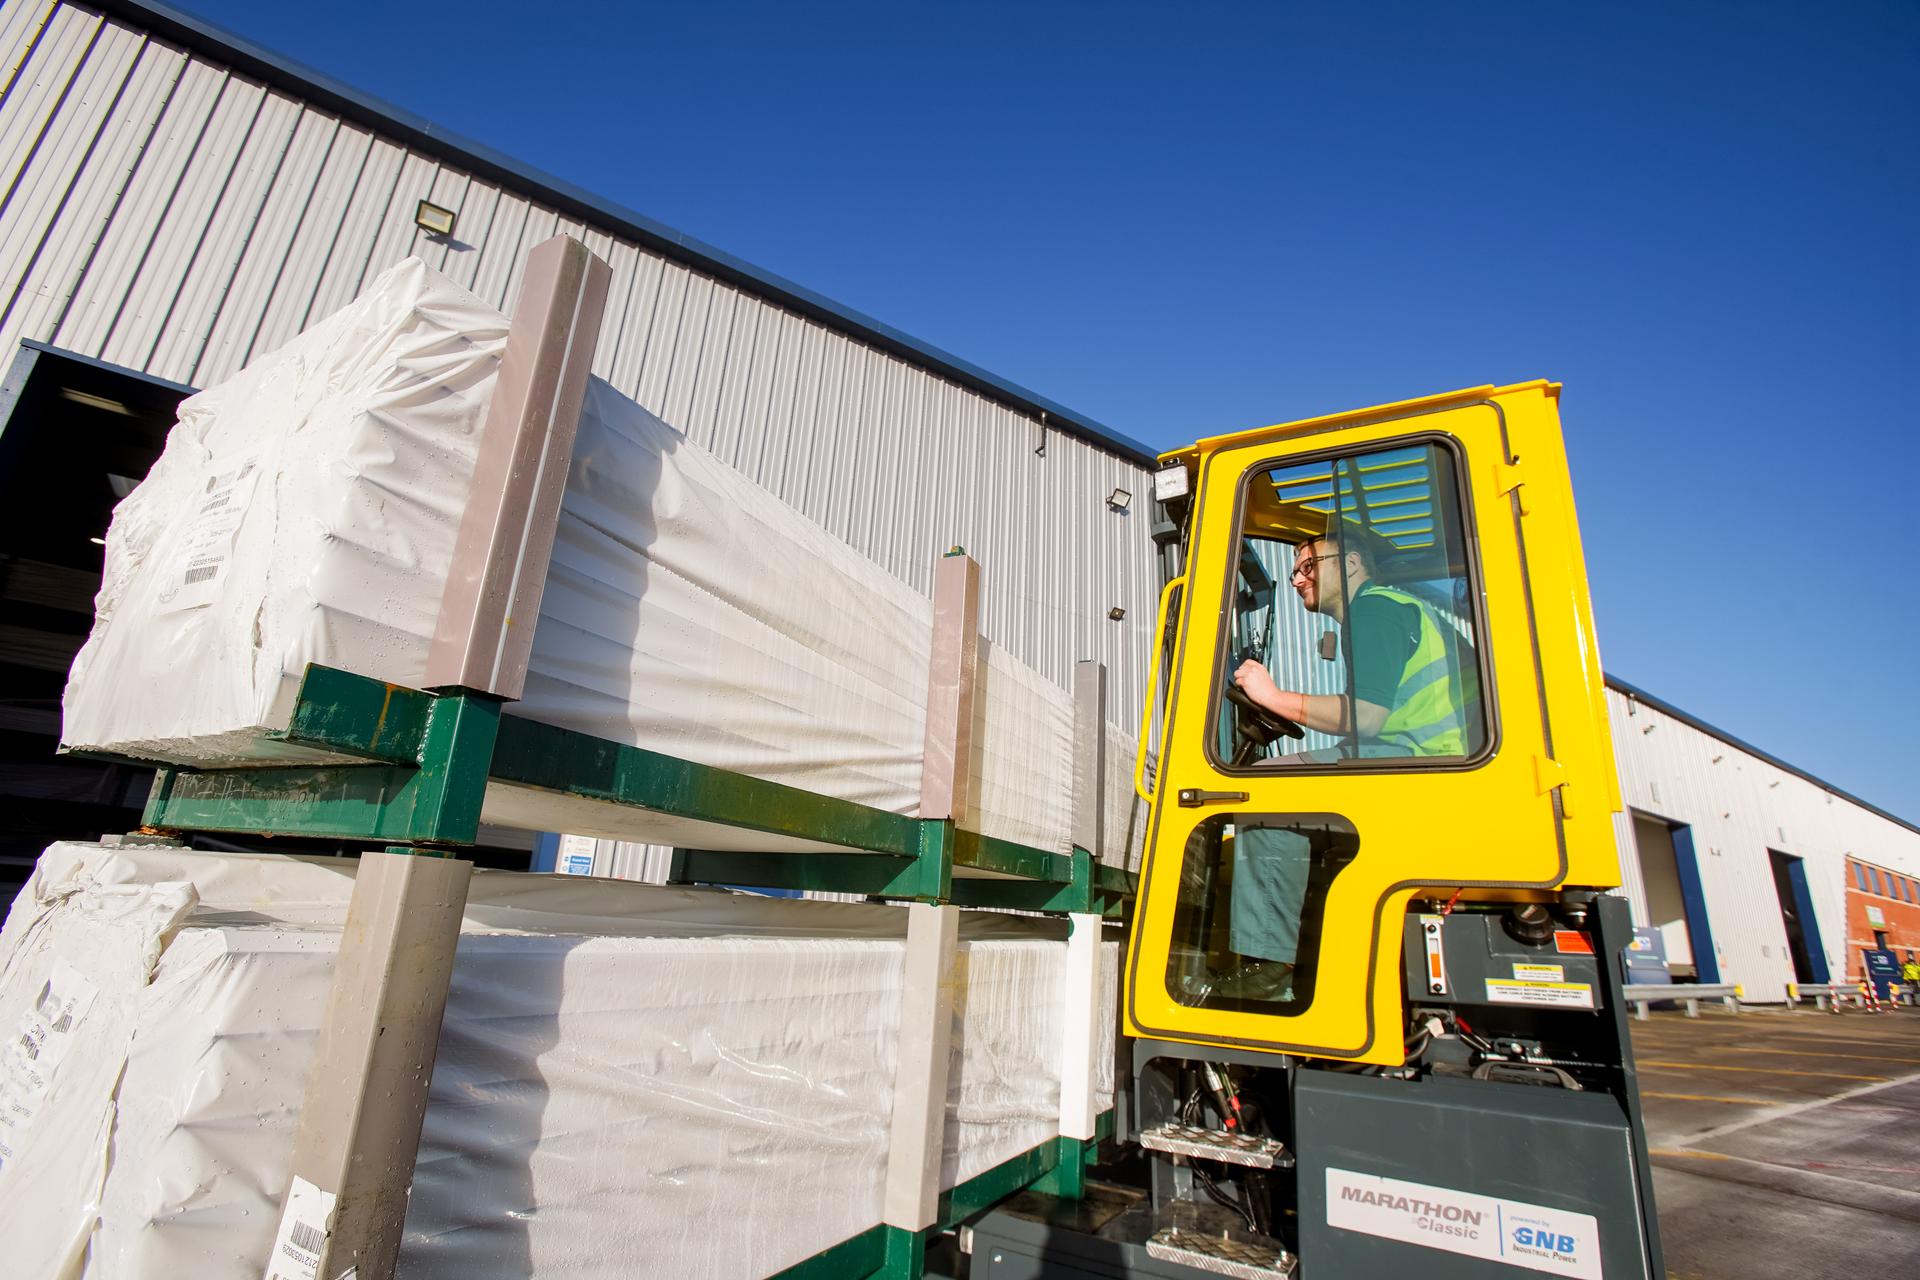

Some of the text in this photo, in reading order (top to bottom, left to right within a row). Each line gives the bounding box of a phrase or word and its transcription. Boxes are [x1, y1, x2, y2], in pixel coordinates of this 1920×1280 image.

[1341, 1186, 1482, 1226] MARATHON
[1416, 1216, 1479, 1240] Classic
[1510, 1215, 1550, 1228] powered by
[1512, 1227, 1575, 1253] GNB
